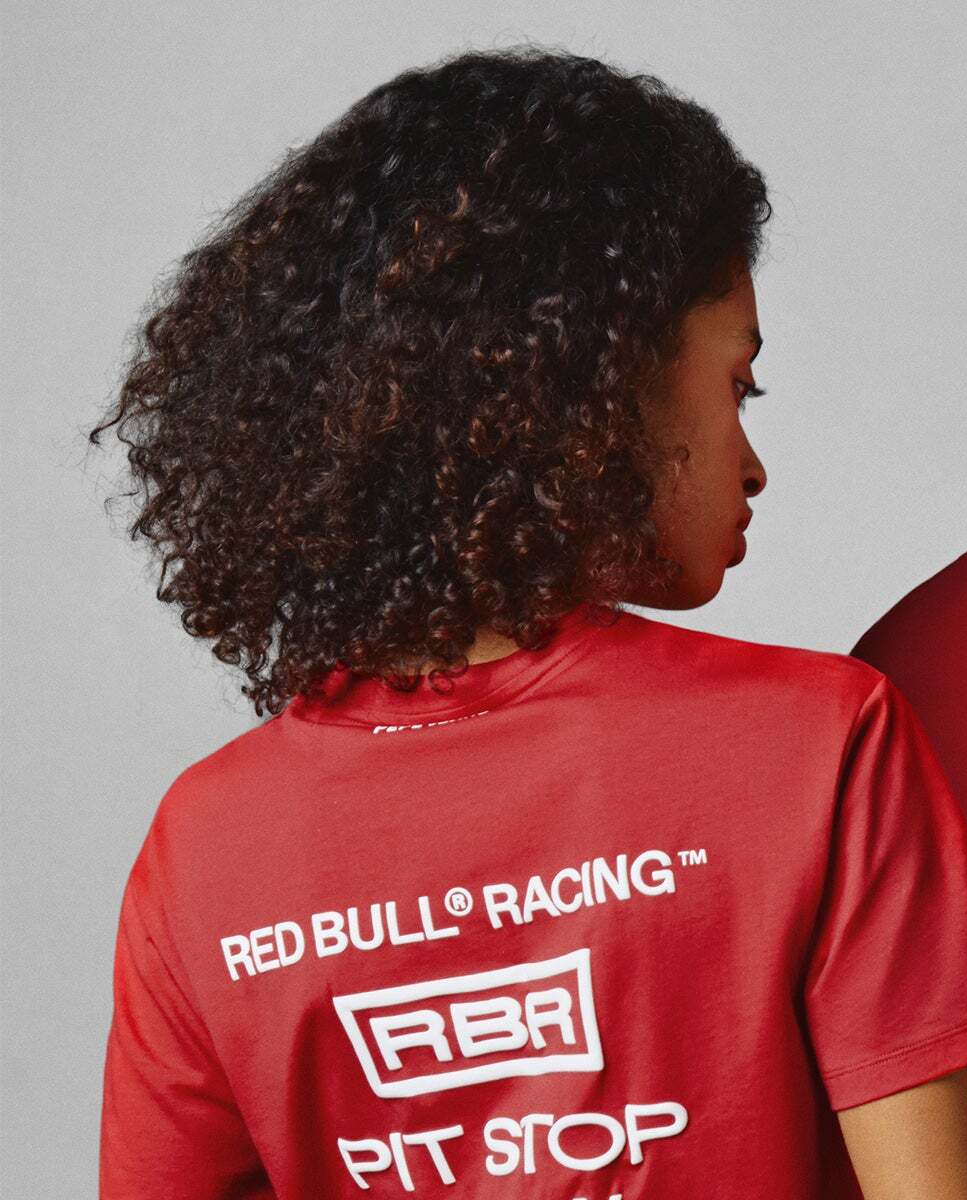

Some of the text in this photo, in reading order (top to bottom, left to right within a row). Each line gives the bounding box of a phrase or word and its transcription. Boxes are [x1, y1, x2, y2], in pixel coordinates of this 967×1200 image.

[220, 921, 305, 981] RED
[369, 986, 577, 1071] RBR
[337, 1101, 689, 1192] PIT STOP
